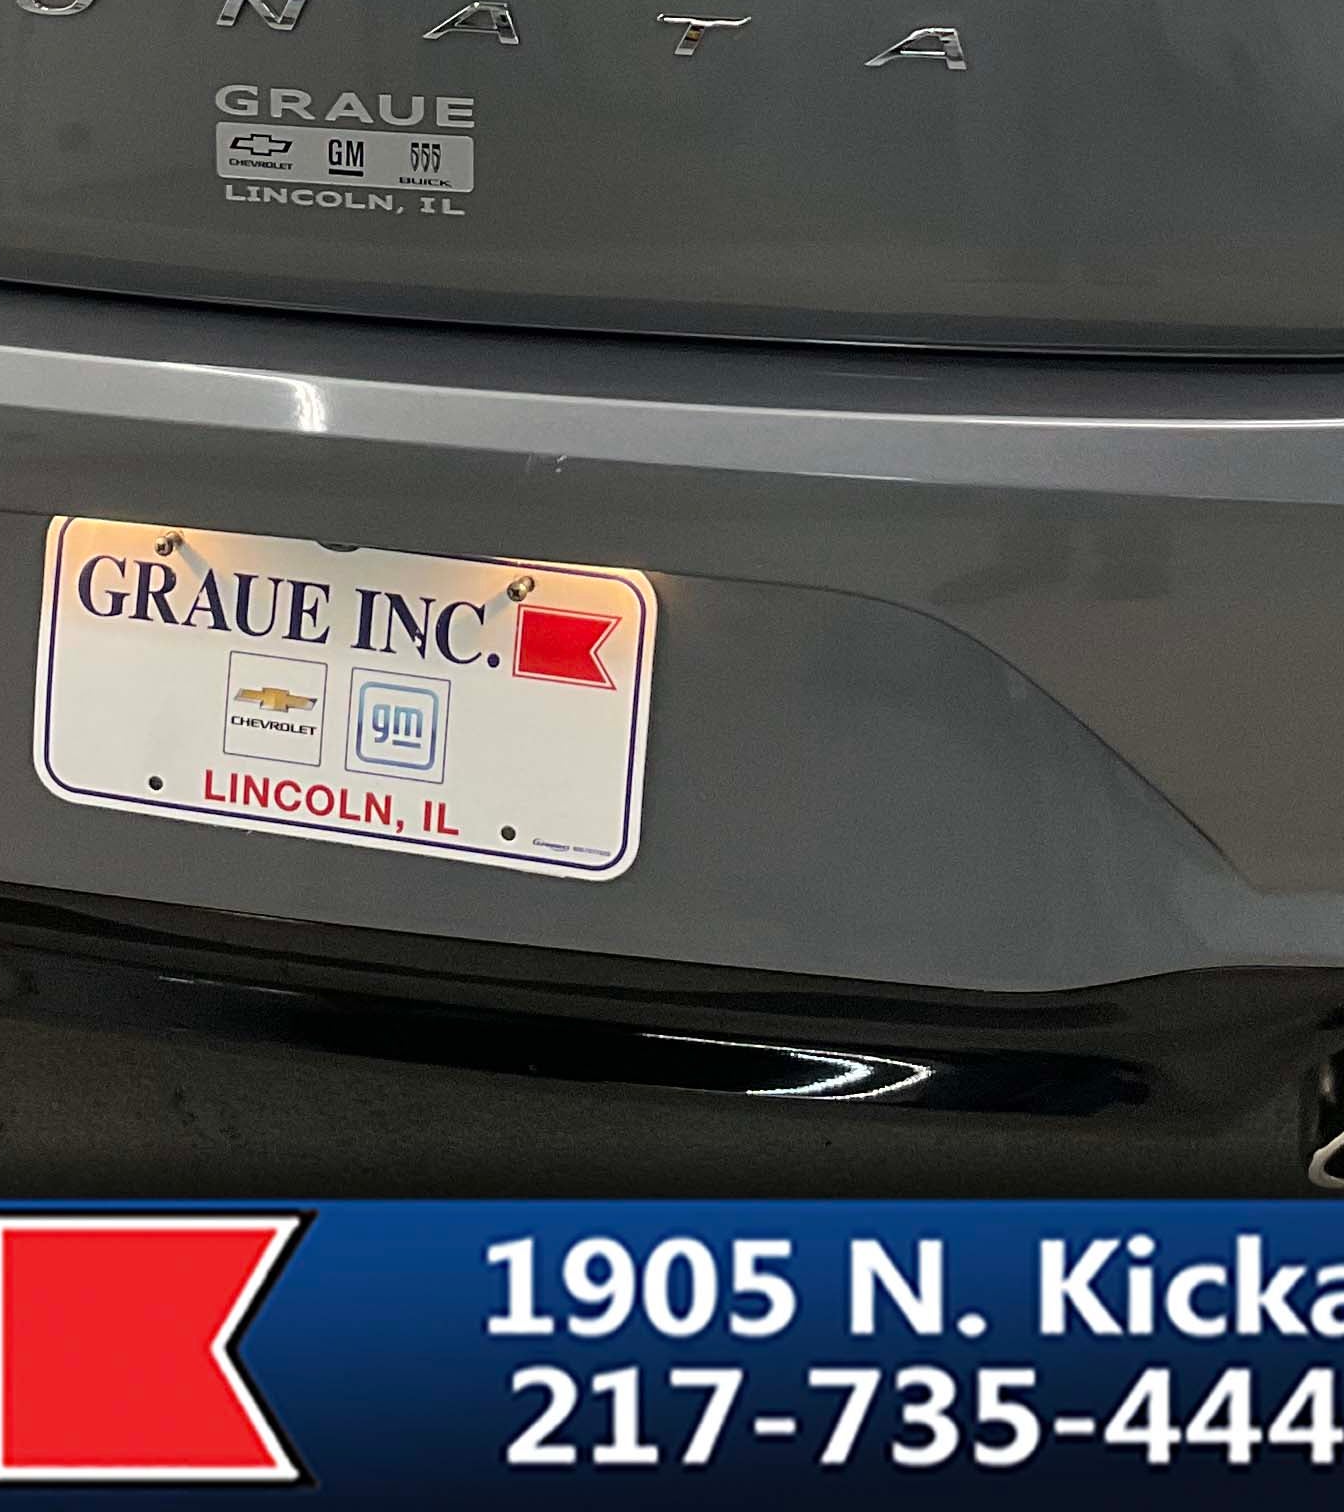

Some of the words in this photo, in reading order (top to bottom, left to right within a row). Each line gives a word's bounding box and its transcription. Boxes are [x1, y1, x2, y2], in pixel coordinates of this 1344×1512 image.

[215, 84, 476, 129] GRAUE
[228, 157, 294, 171] CHEVROLET
[328, 138, 365, 168] GM
[398, 176, 453, 188] BUICK
[224, 184, 405, 215] LINCOLN,
[419, 196, 466, 216] IL
[76, 554, 331, 644] GRAUE
[350, 587, 501, 668] INC.
[230, 714, 318, 737] CHEVROLET
[371, 704, 423, 745] gm
[204, 769, 405, 833] LINCOLN,
[423, 800, 460, 836] IL
